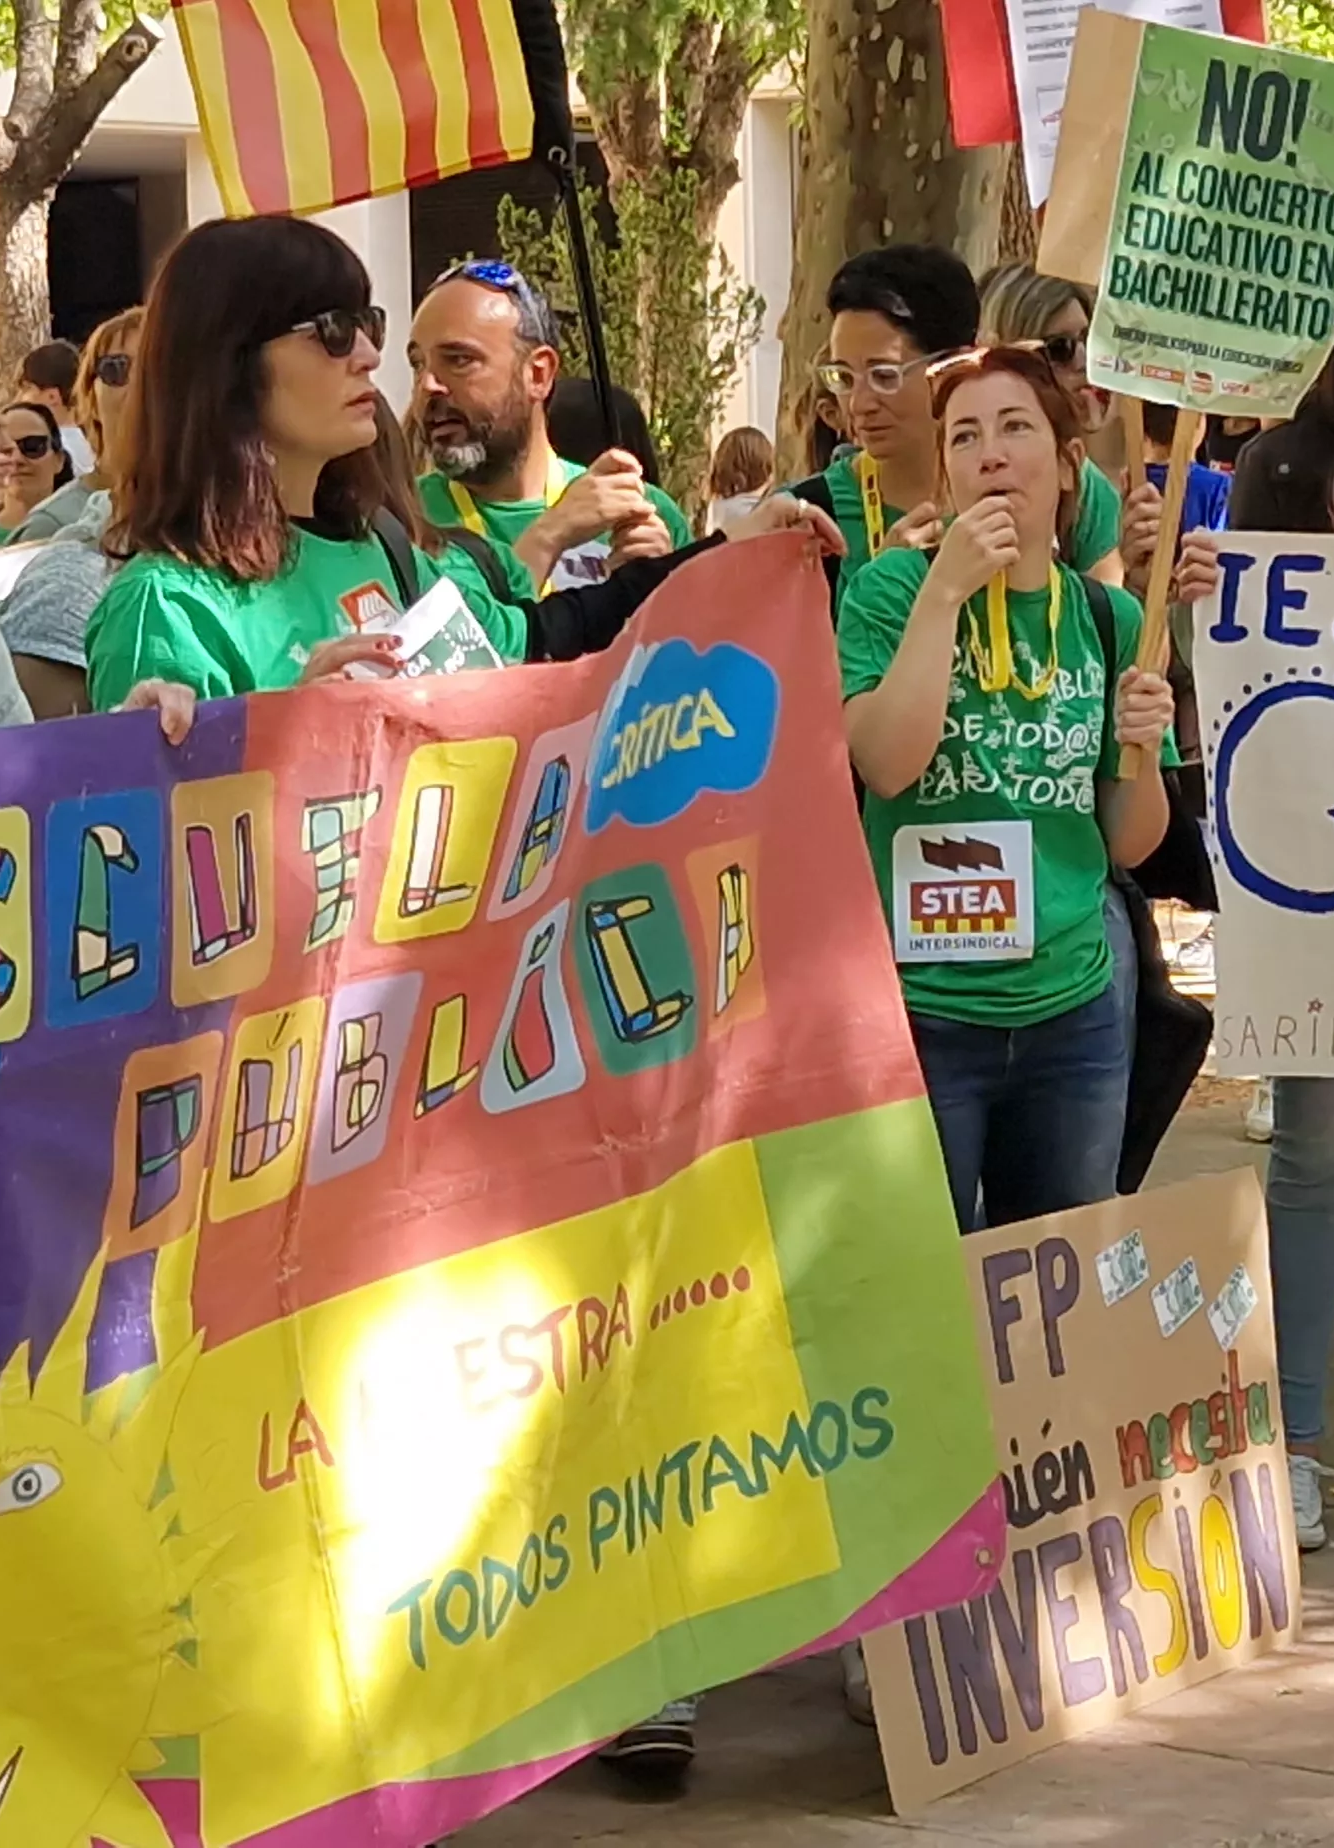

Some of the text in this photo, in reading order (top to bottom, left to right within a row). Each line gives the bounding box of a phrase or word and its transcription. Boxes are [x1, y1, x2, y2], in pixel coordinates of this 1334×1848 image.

[1197, 59, 1311, 168] NO!
[1131, 151, 1168, 198] AL
[1124, 203, 1294, 279] EDUCATIVO
[1108, 255, 1331, 341] BACHILLERATO
[909, 935, 1020, 951] INTERSINDICAL
[920, 885, 1007, 915] STEA
[982, 1237, 1080, 1384] FP
[257, 1398, 336, 1492] LA
[1116, 1349, 1279, 1489] necesita
[386, 1386, 896, 1672] TODOS PINTAMOS
